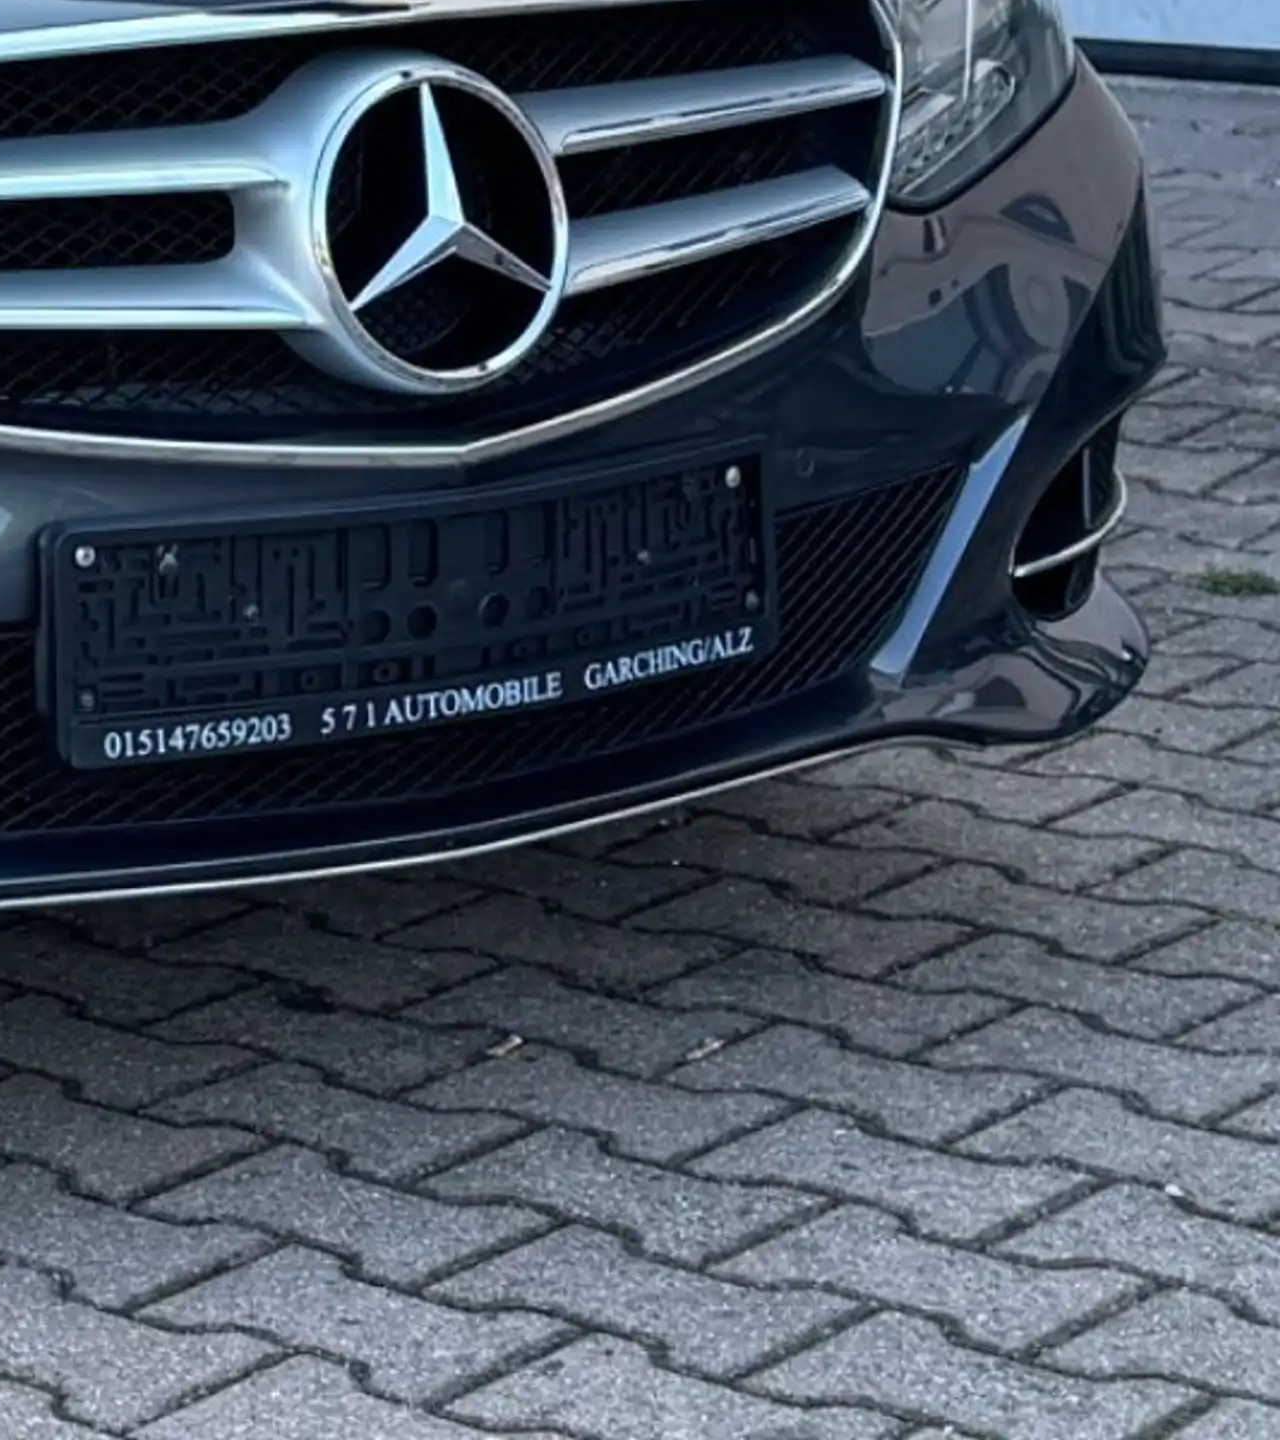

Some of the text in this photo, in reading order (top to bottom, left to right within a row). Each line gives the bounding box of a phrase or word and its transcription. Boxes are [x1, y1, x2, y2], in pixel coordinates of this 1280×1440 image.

[103, 713, 292, 759] 015147659203
[383, 672, 563, 726] AUTOMOBILE
[584, 626, 755, 691] GARCHING/ALZ
